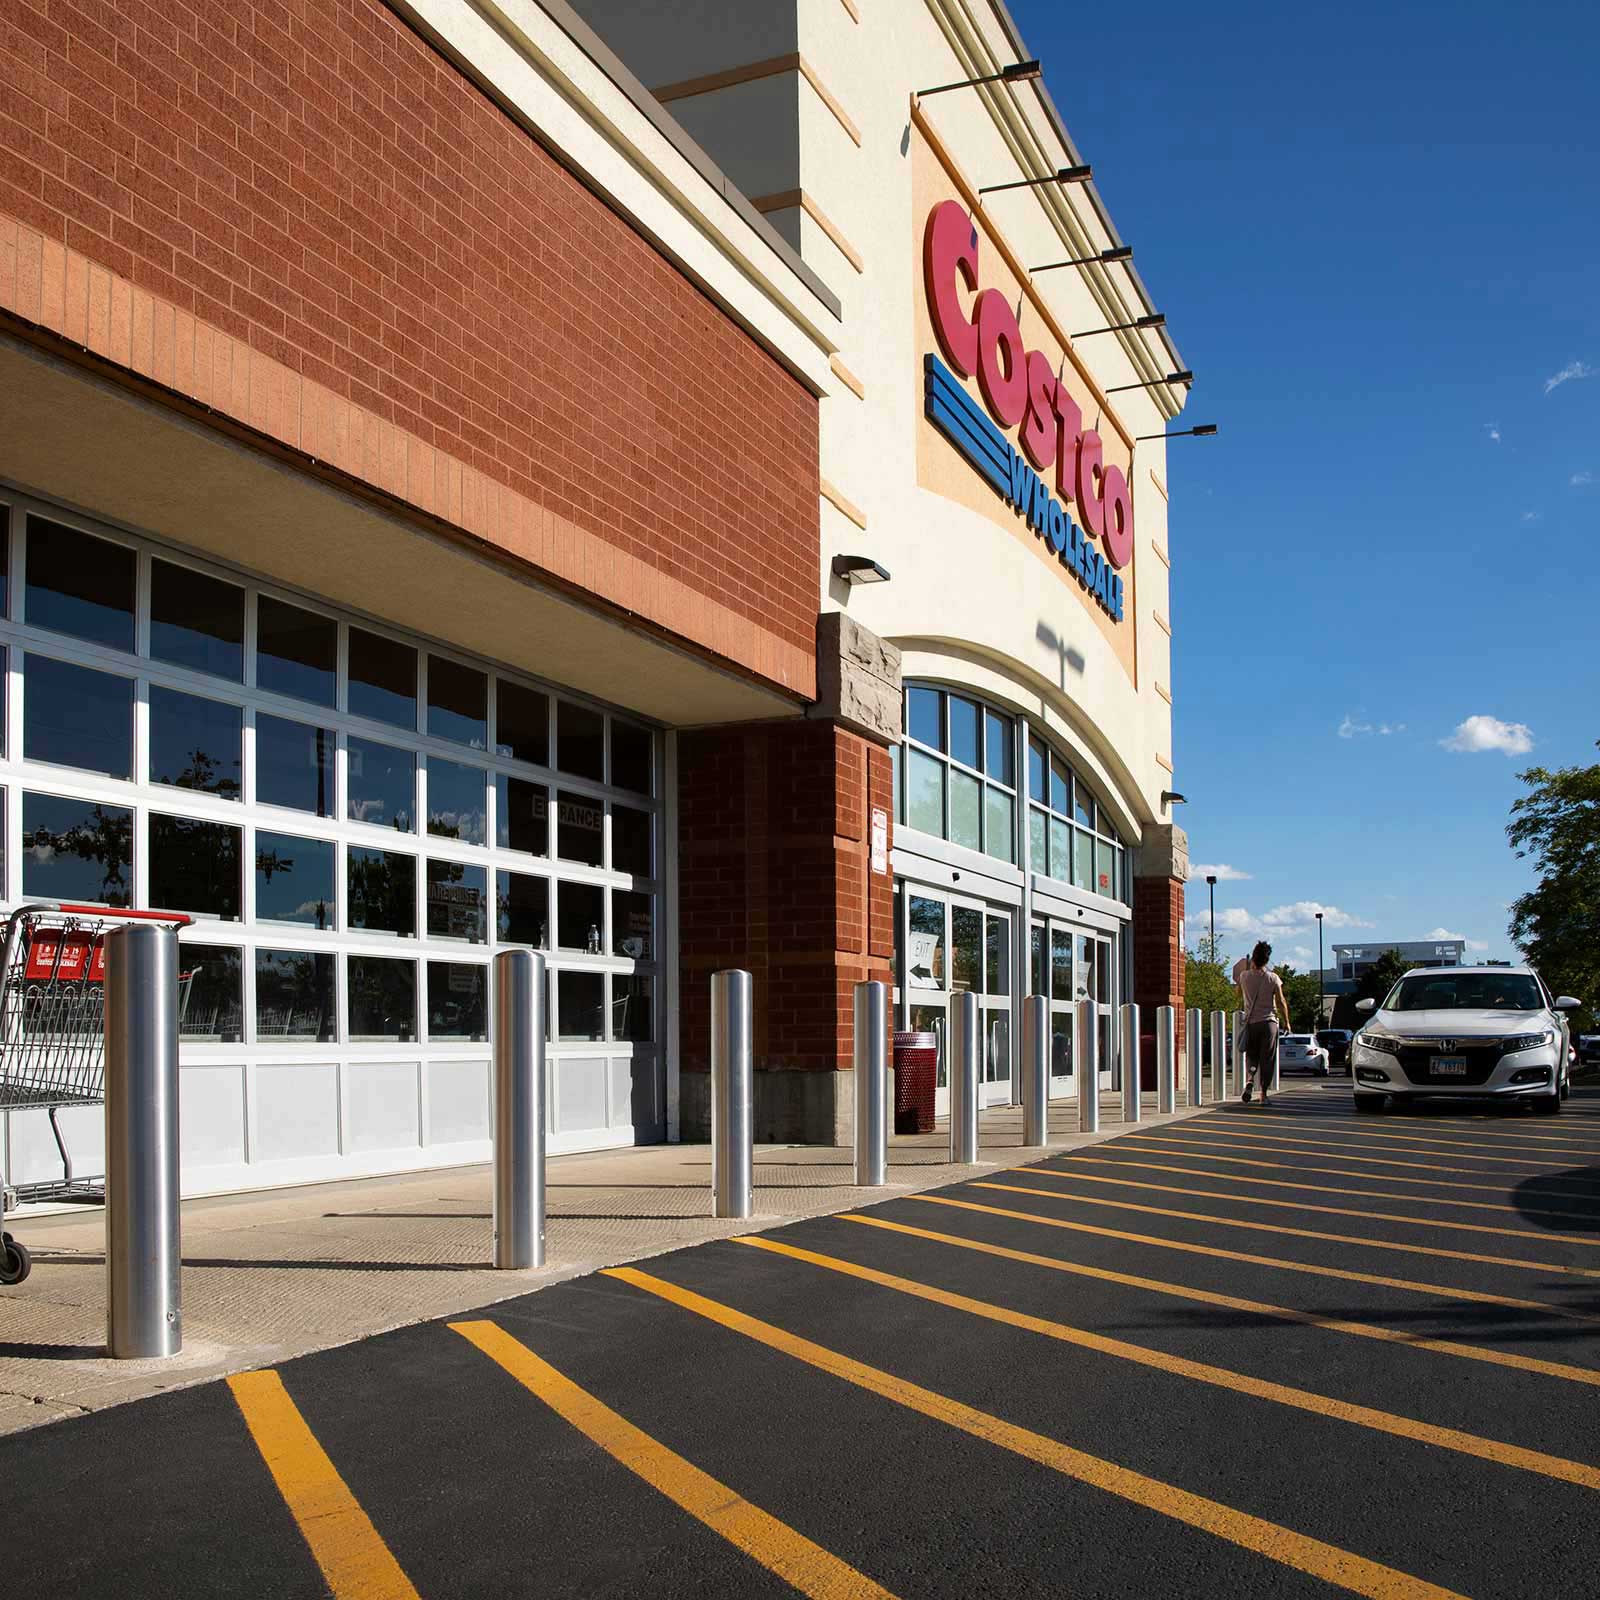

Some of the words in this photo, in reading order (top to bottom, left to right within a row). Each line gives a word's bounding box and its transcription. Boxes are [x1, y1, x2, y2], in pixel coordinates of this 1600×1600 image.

[923, 200, 1132, 569] COSTCO
[1006, 444, 1123, 622] WHOLESALE
[535, 798, 600, 828] ERANCE
